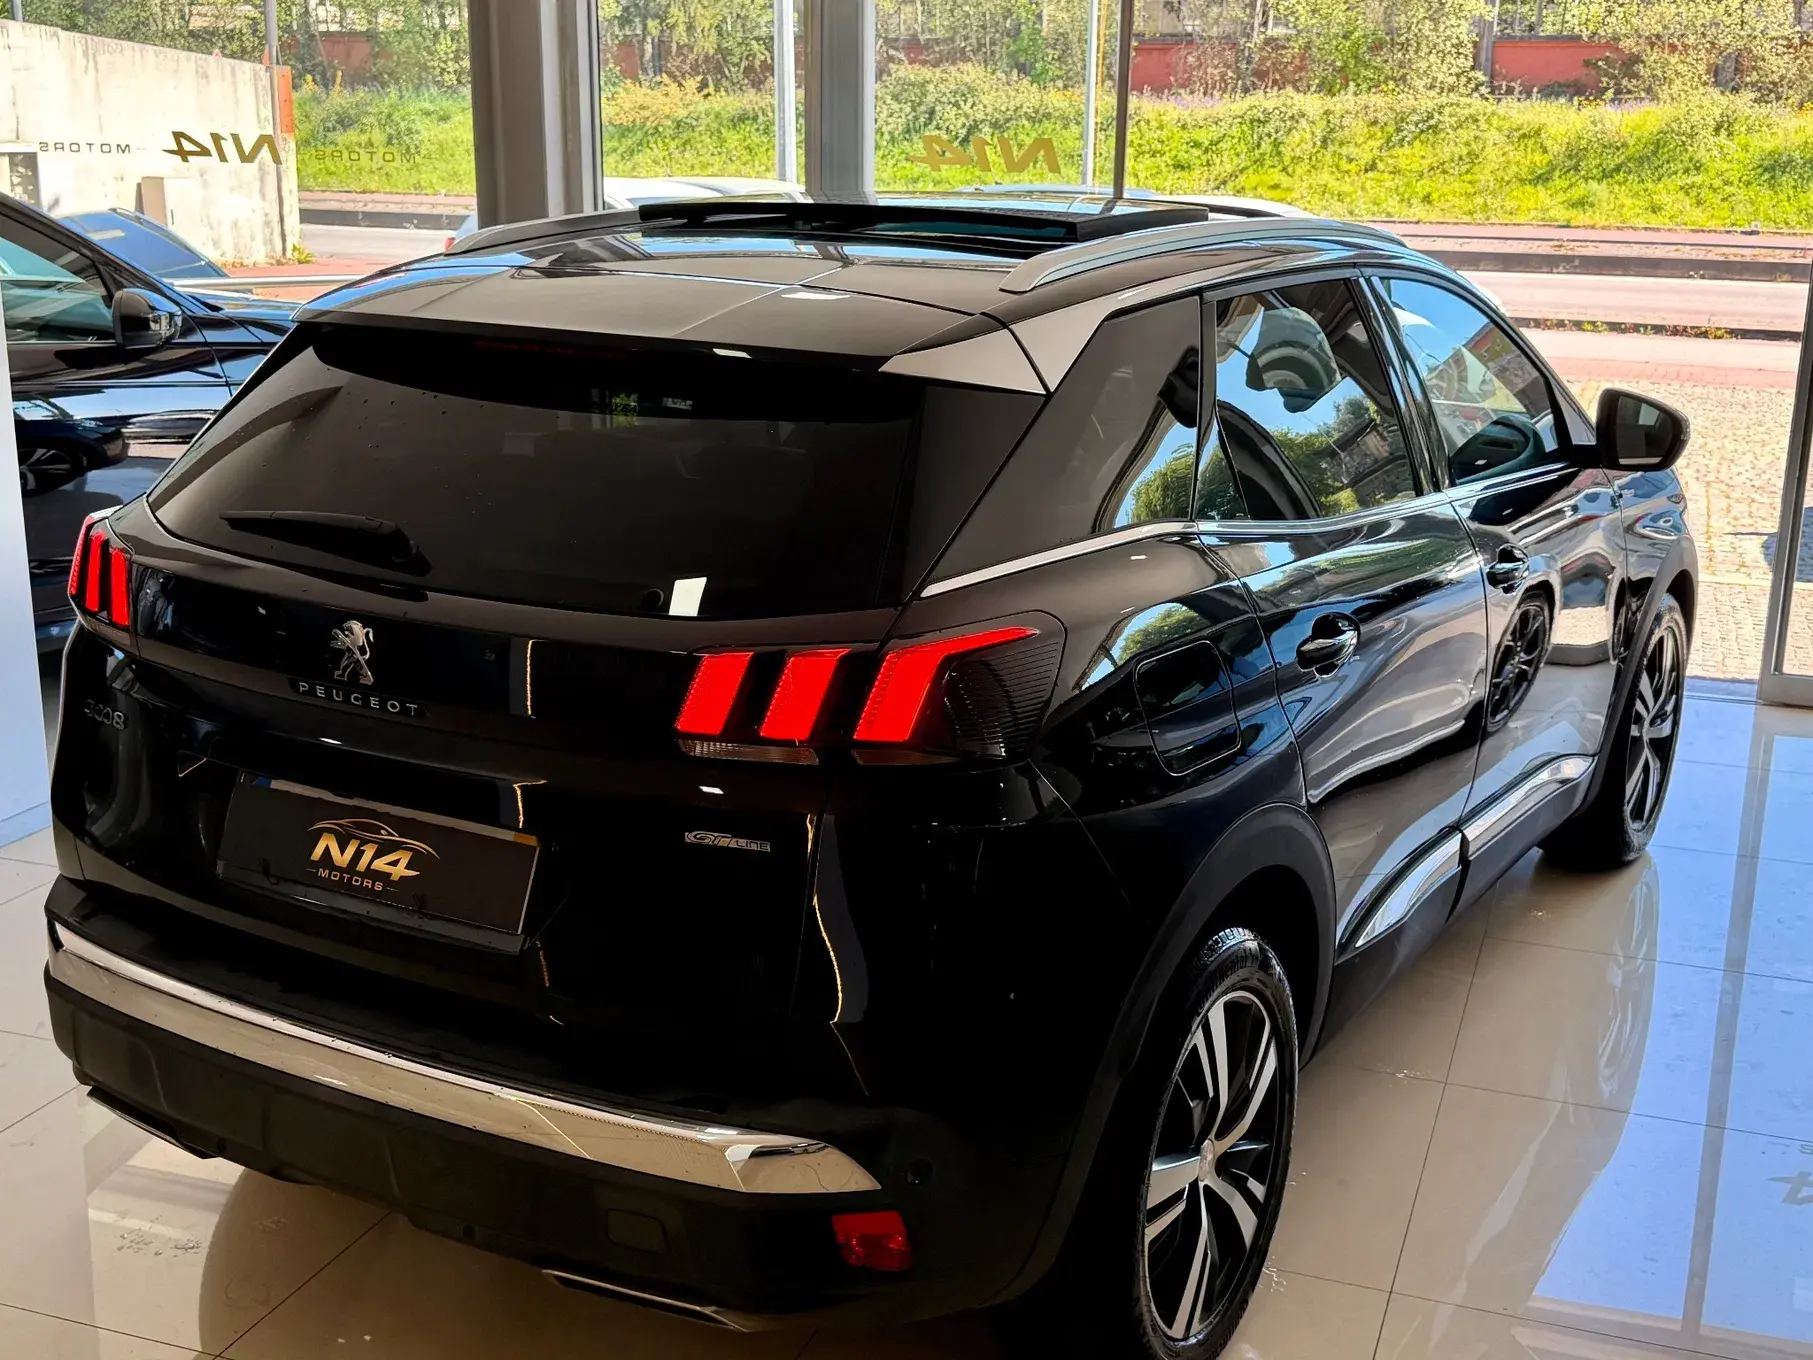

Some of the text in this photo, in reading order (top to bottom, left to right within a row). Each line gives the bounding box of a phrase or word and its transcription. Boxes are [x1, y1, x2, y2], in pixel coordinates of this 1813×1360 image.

[299, 682, 418, 716] PEUGEOT
[309, 832, 421, 881] N14
[318, 867, 384, 891] MOTORS
